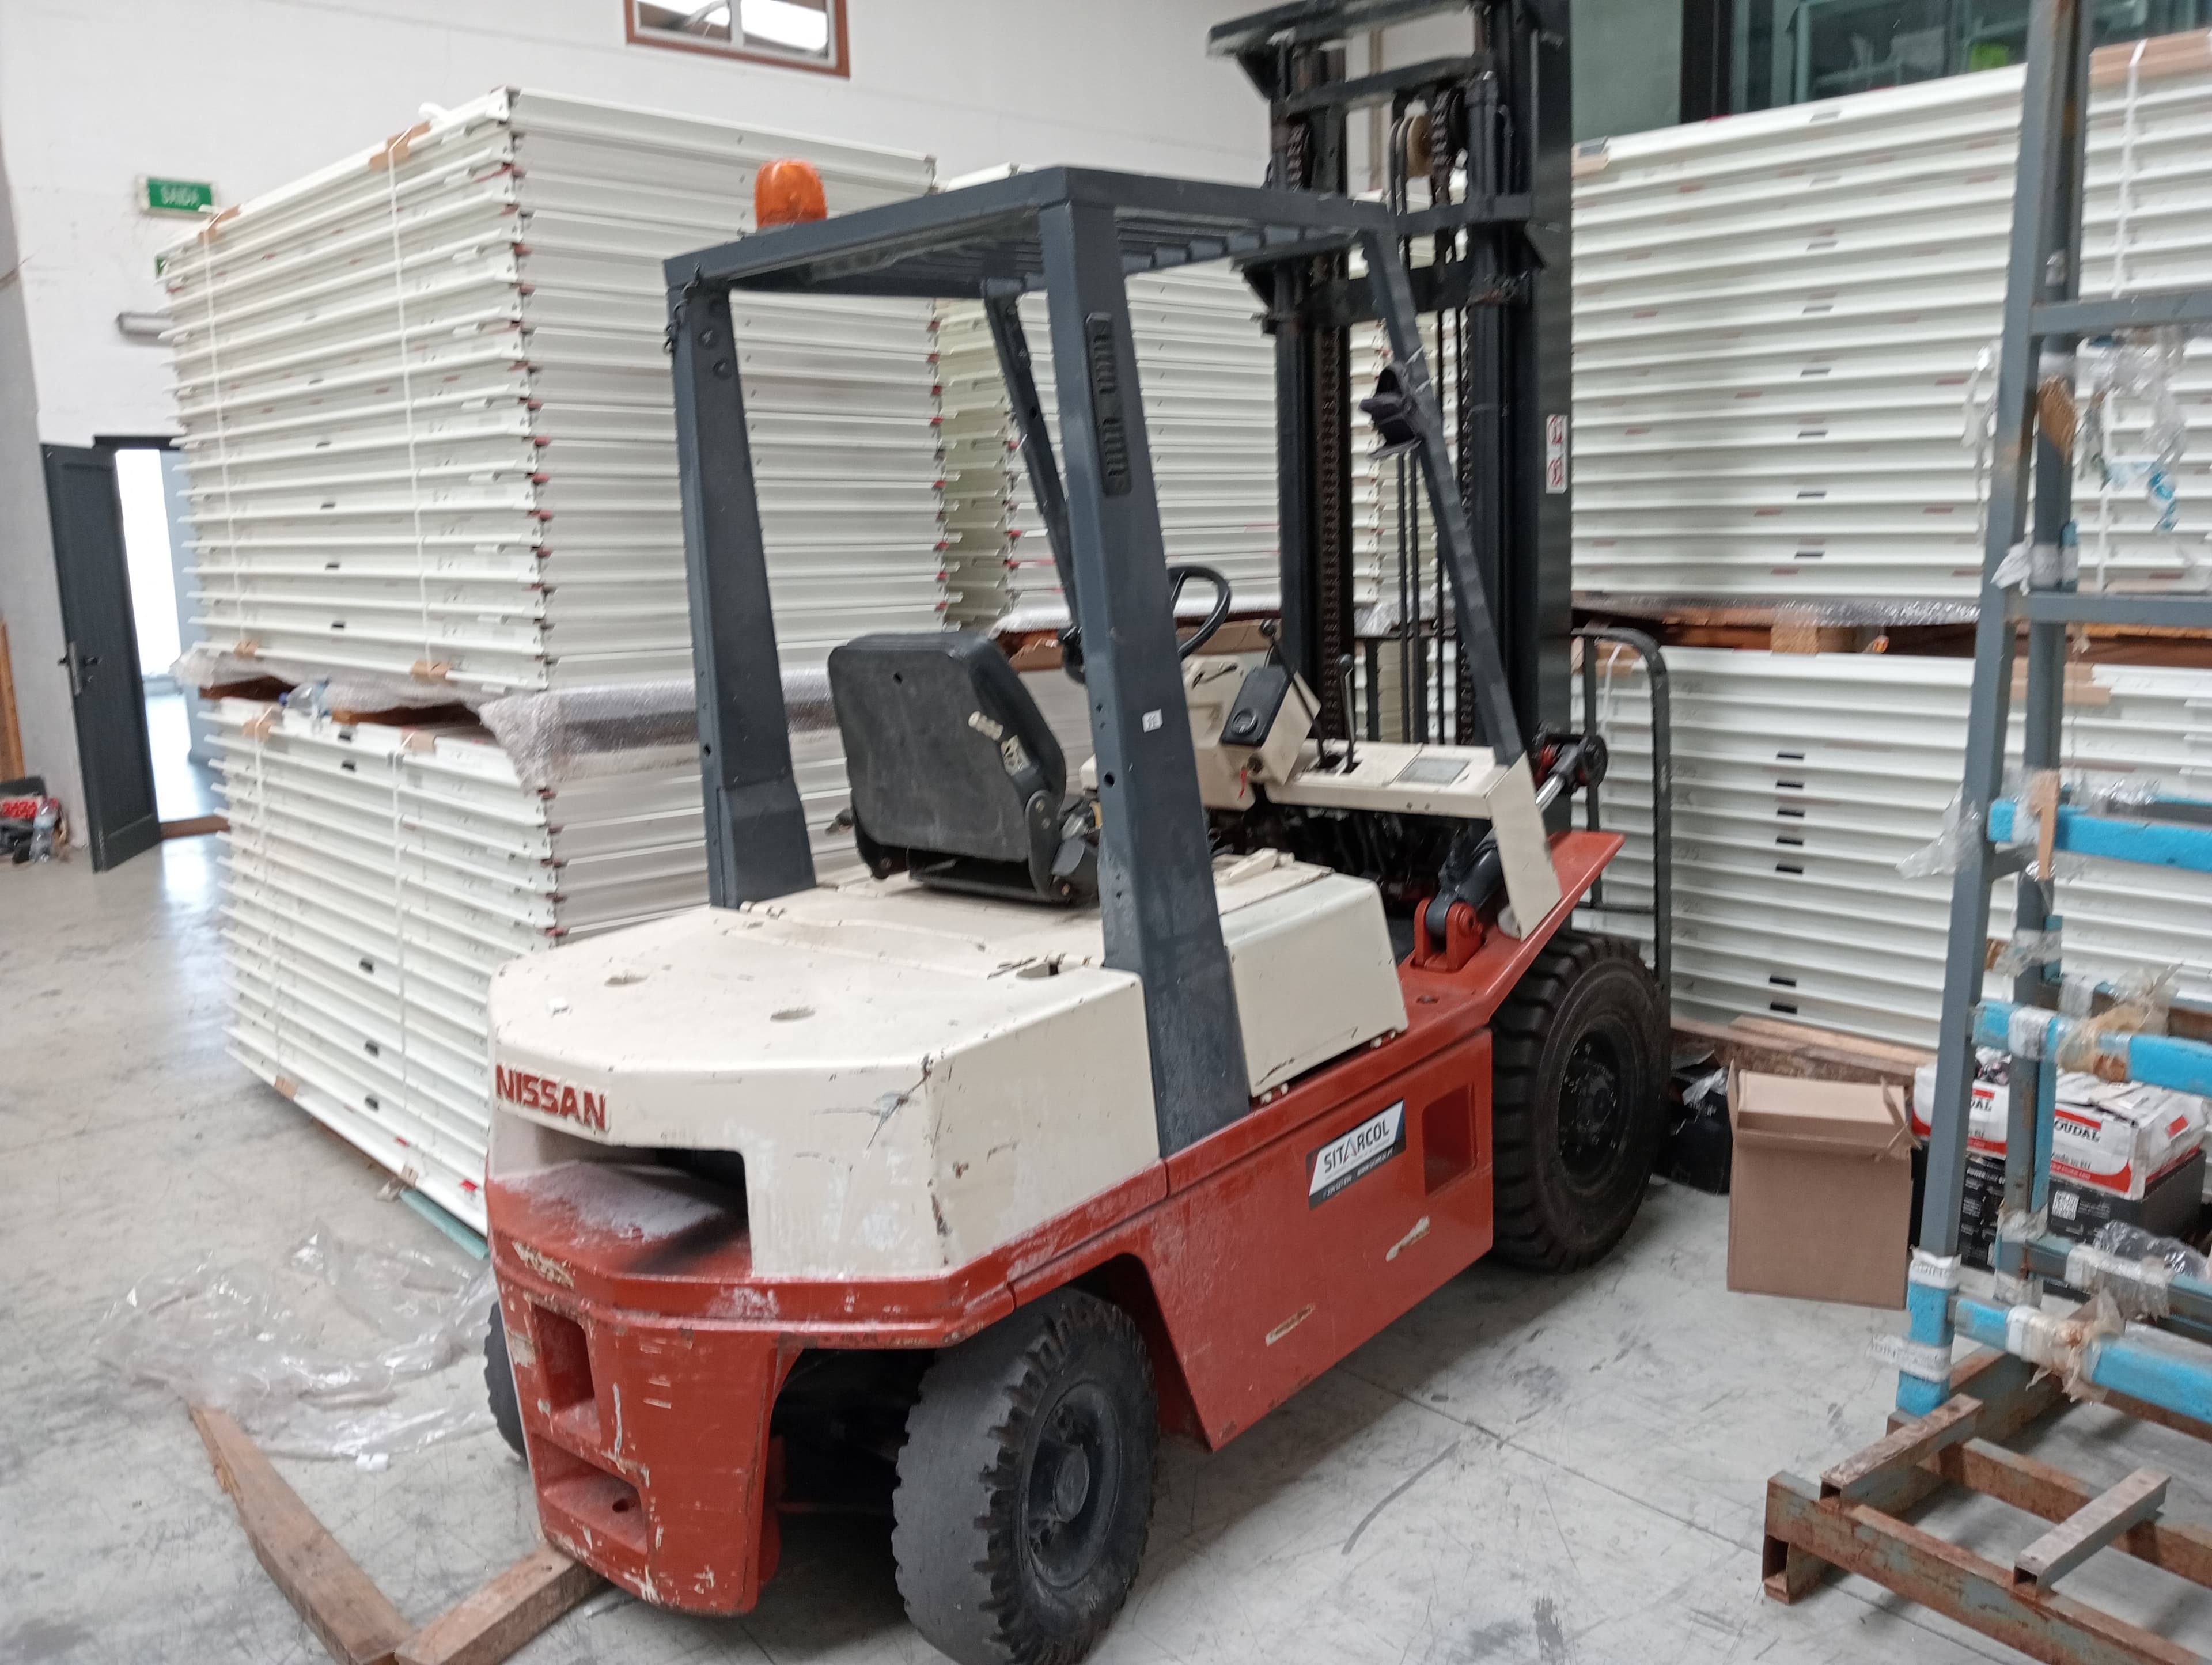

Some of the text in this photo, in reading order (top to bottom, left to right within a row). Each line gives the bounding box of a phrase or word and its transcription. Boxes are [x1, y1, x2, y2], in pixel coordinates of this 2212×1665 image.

[496, 1064, 605, 1131] NISSAN
[1323, 1119, 1390, 1174] SITARCOL
[2054, 1120, 2101, 1143] OUDAL
